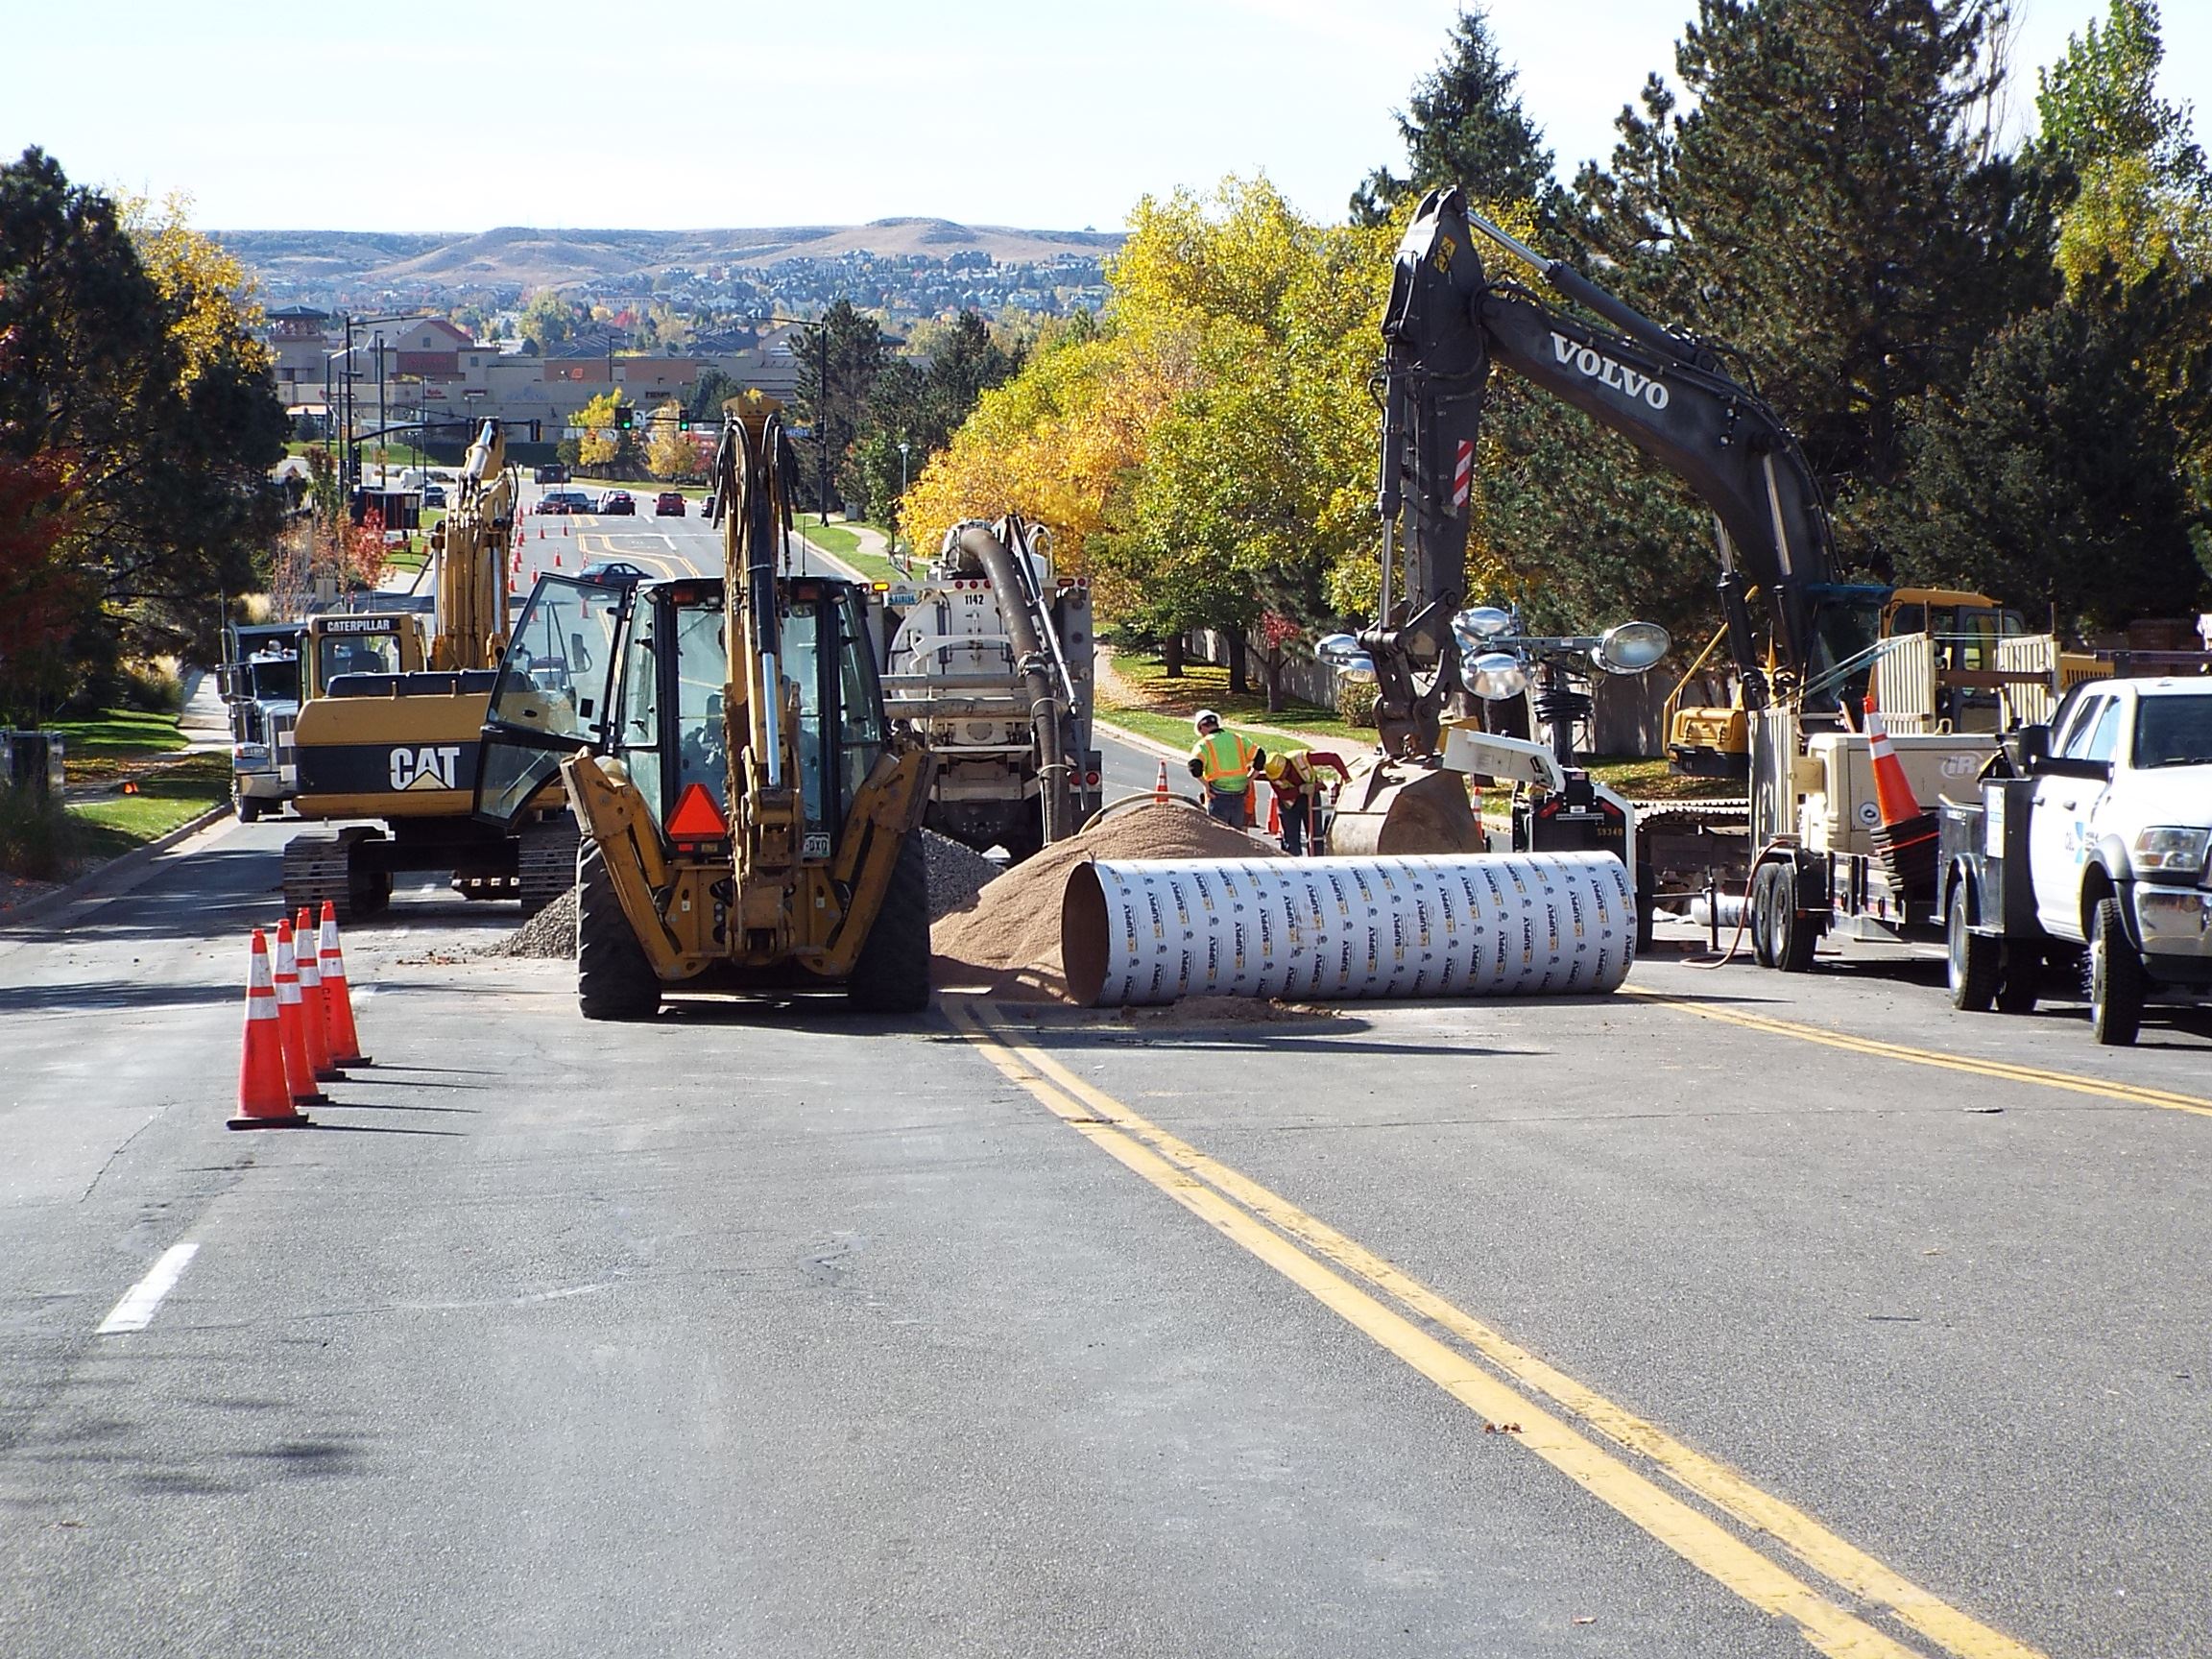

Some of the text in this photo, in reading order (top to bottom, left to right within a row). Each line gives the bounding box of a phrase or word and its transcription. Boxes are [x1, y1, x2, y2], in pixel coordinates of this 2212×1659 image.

[1550, 331, 1670, 410] VOLVO
[964, 594, 984, 605] 1142
[327, 619, 390, 633] CATERPILLAR
[390, 747, 460, 791] CAT
[1170, 881, 1184, 910] SUPPLY
[1192, 873, 1208, 898] SUPPLY
[1329, 875, 1343, 902] SUPPLY
[1460, 877, 1476, 906] SUPPLY
[1480, 868, 1498, 894] SUPPLY
[1590, 878, 1604, 910] SUPPLY
[1611, 870, 1627, 897] SUPPLY
[1146, 892, 1160, 924] SUPPLY
[1283, 895, 1295, 928] SUPPLY
[1306, 884, 1320, 915] SUPPLY
[1438, 887, 1452, 919] SUPPLY
[1569, 891, 1581, 924] SUPPLY
[1123, 903, 1134, 938] SUPPLY
[1260, 908, 1269, 942] SUPPLY
[1392, 912, 1402, 947] SUPPLY
[1416, 899, 1428, 932] SUPPLY
[1546, 903, 1555, 937] SUPPLY
[1180, 950, 1189, 980] SUPPLY
[1340, 940, 1349, 972] SUPPLY
[1470, 945, 1479, 974] SUPPLY
[1596, 948, 1606, 976] SUPPLY
[1623, 934, 1631, 965] SUPPLY
[1312, 953, 1322, 982] SUPPLY
